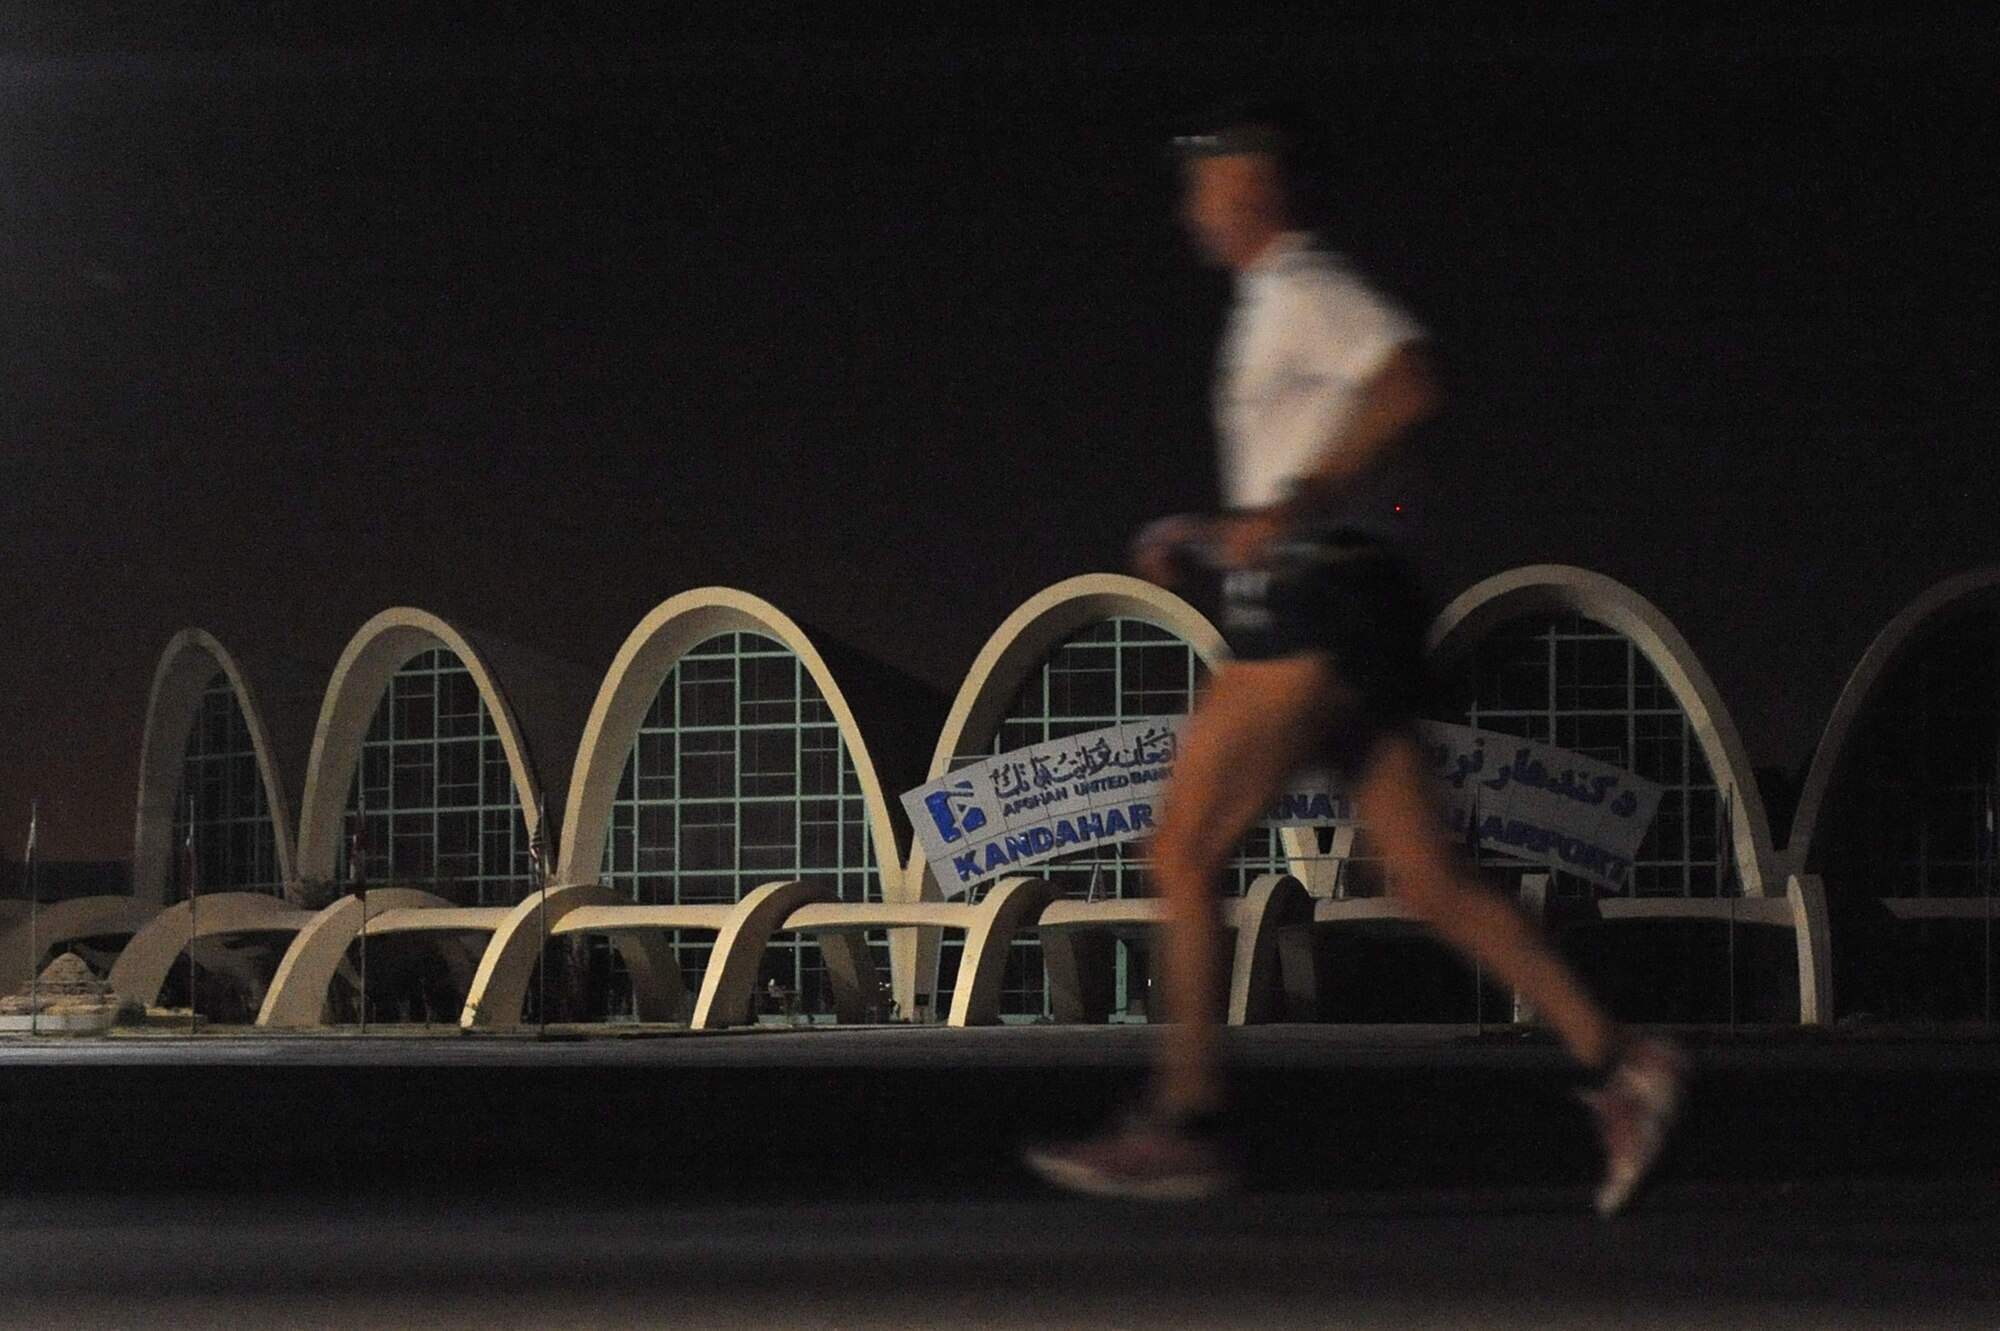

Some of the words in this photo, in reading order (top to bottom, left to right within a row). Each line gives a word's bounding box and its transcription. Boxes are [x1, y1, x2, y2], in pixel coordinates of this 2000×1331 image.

[1003, 786, 1068, 817] AFGHAN
[1073, 775, 1129, 796] UNITED
[953, 803, 1155, 882] KANDAHAR
